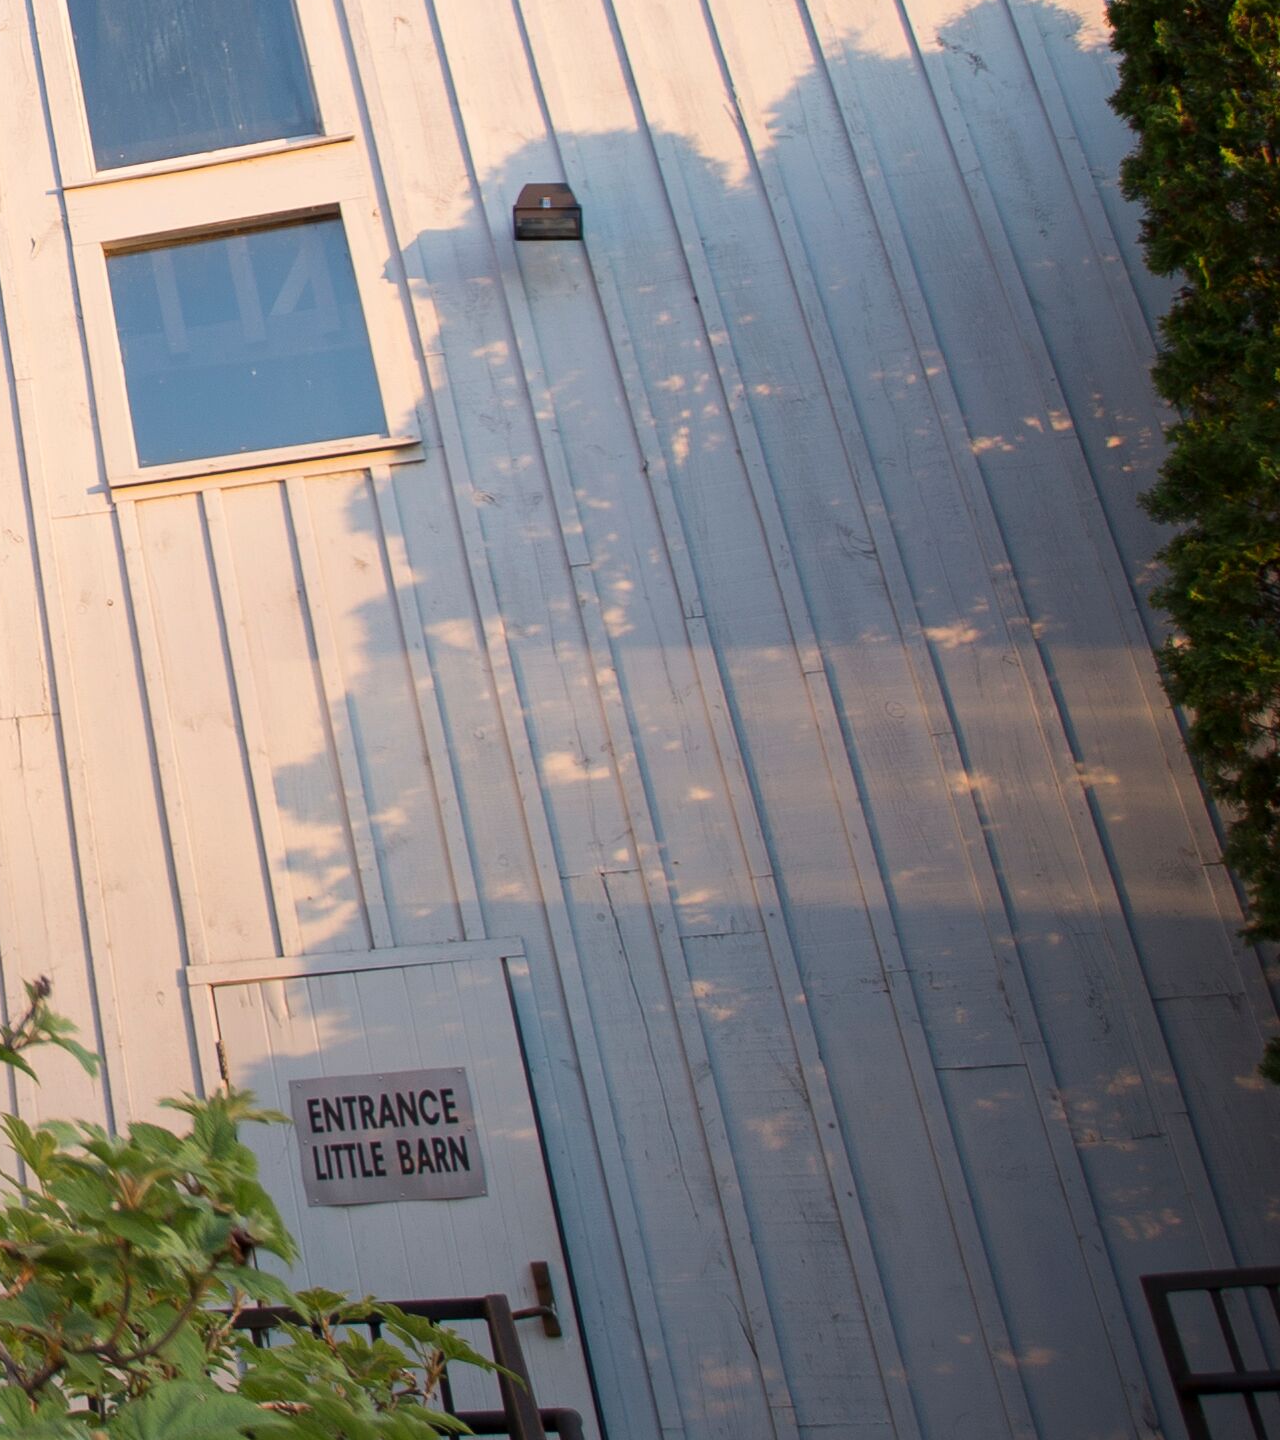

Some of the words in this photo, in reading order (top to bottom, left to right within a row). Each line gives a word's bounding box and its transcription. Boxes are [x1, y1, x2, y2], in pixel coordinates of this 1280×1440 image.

[307, 1088, 459, 1133] ENTRANCE
[312, 1141, 387, 1181] LITTLE
[396, 1135, 471, 1175] BARN
